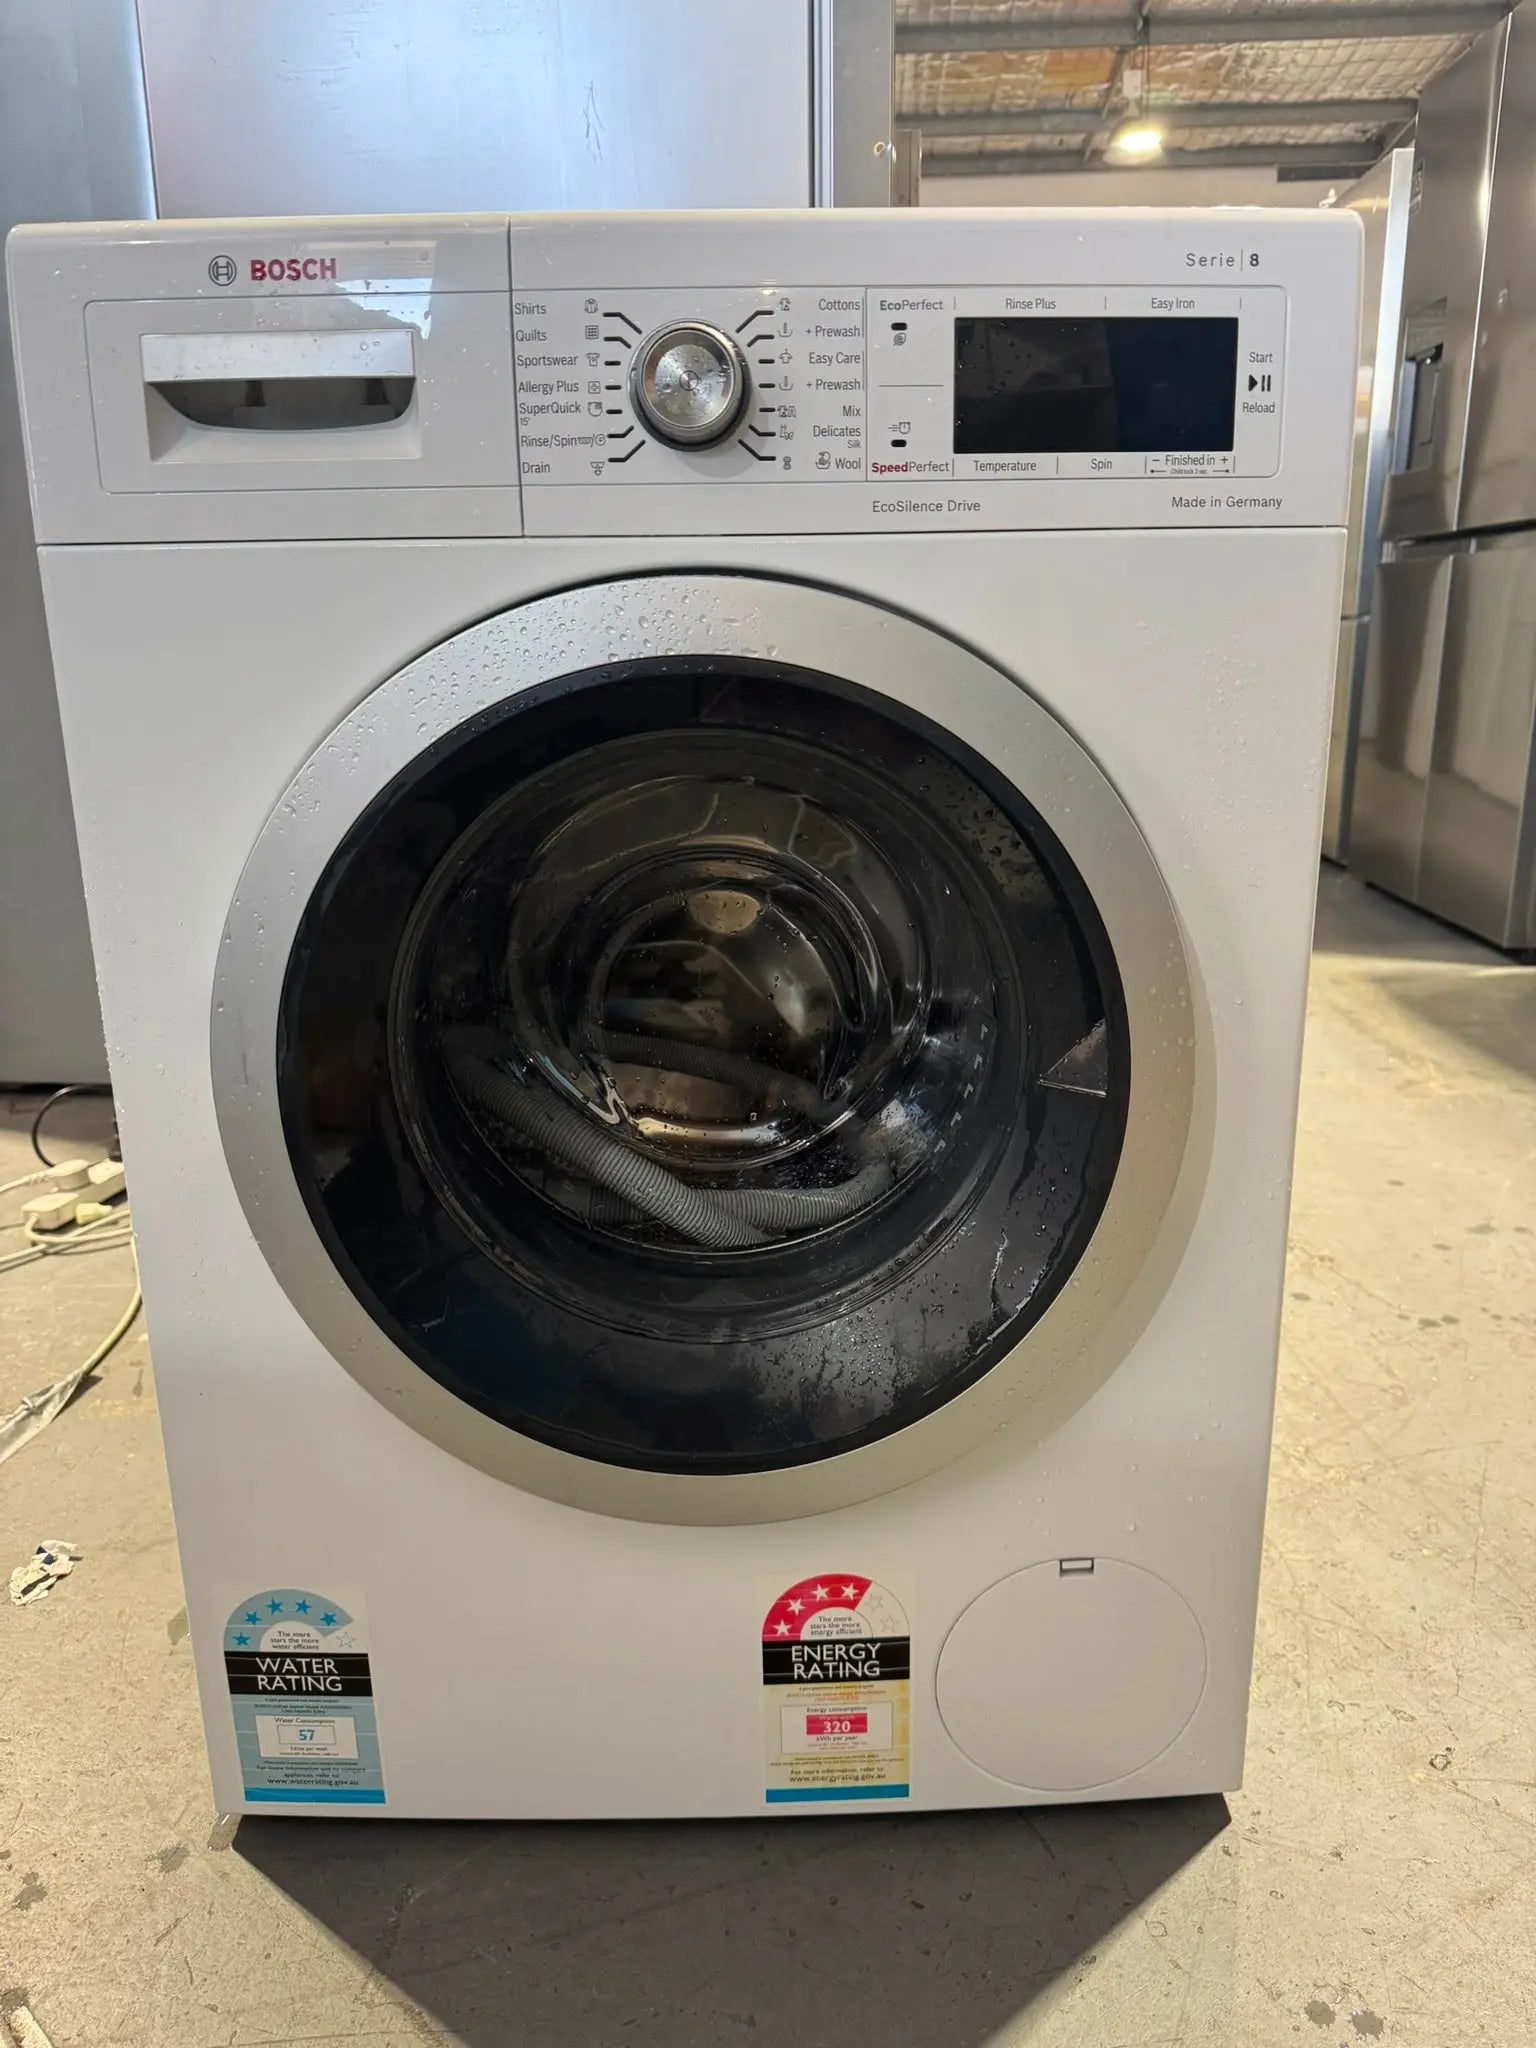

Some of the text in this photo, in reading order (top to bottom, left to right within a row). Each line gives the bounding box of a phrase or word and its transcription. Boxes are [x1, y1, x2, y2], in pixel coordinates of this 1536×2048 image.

[1185, 252, 1260, 268] Serie 8
[250, 258, 337, 281] BOSCH
[514, 302, 547, 316] Shirts
[818, 297, 861, 311] Cottons
[879, 298, 944, 311] EcoPerfect
[1005, 297, 1057, 310] Rinse Plus
[1150, 296, 1196, 312] Easy Iron
[515, 329, 548, 343] Quilts
[815, 325, 861, 338] Prewash
[517, 354, 579, 368] Sportswear
[808, 351, 861, 368] Easy Care
[1248, 351, 1274, 364] Start
[518, 379, 579, 395] Allergy Plus
[815, 378, 861, 391] Prewash
[519, 401, 582, 417] SuperQuick
[842, 404, 861, 417] Mix
[1241, 401, 1276, 414] Reload
[812, 425, 861, 438] Delicates
[520, 434, 578, 450] Rinse/Spin
[847, 438, 861, 449] Silk
[835, 457, 861, 470] Wool
[973, 459, 1037, 474] Temperature
[1090, 458, 1113, 472] Spin
[1165, 453, 1216, 466] Finished in
[522, 461, 551, 475] Drain
[871, 460, 950, 475] SpeedPerfect
[872, 499, 981, 513] EcoSilence Drive
[1171, 495, 1283, 510] Made in Germany
[810, 1629, 833, 1637] energy
[791, 1642, 881, 1662] ENERGY
[255, 1657, 338, 1674] WATER
[793, 1660, 880, 1680] RATING
[256, 1675, 343, 1692] RATING
[823, 1720, 851, 1733] 320
[298, 1728, 315, 1742] 57
